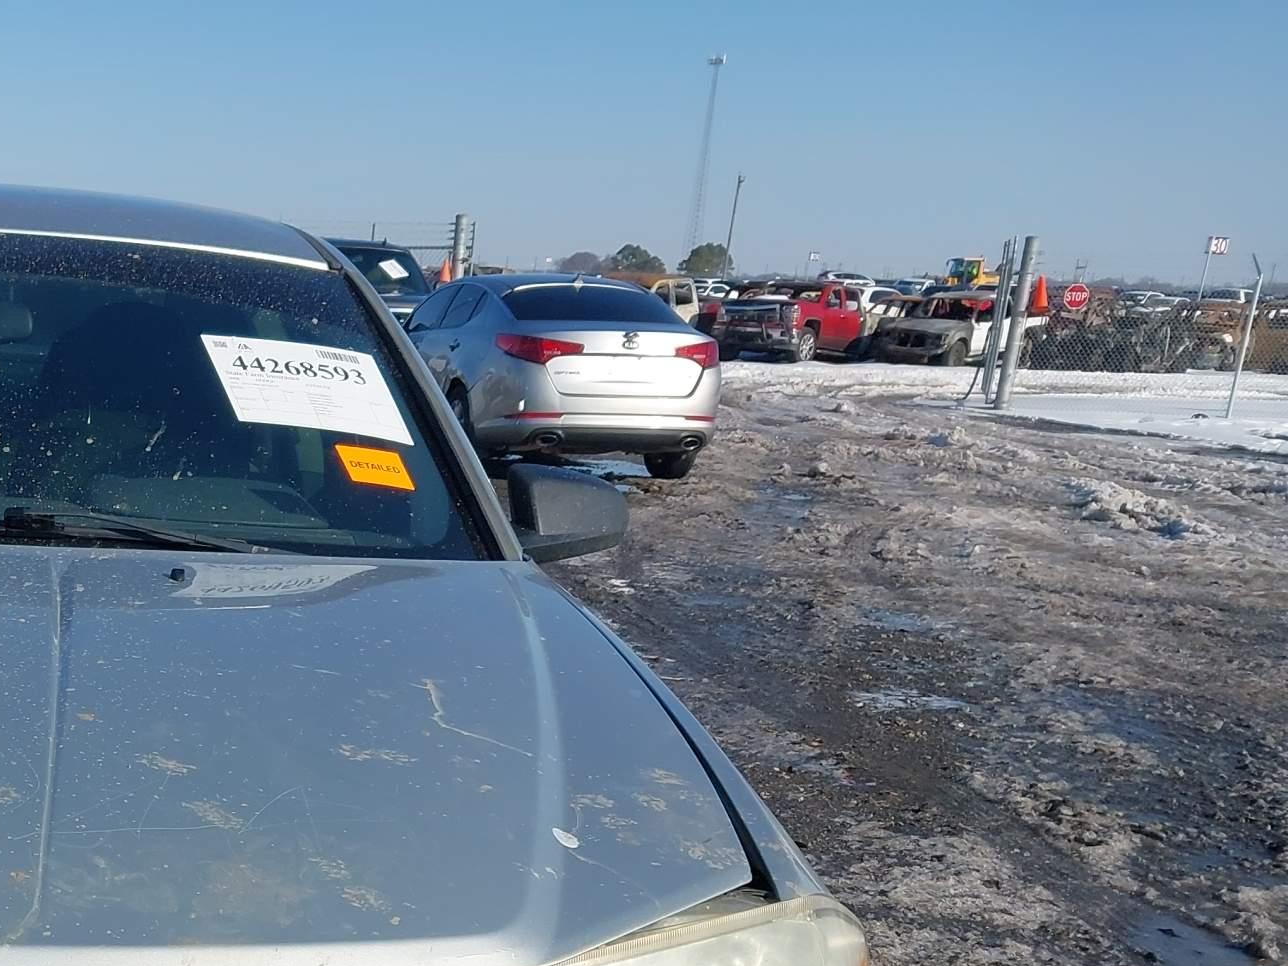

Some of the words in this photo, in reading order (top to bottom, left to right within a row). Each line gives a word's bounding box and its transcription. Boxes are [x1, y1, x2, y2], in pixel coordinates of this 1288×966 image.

[1065, 291, 1088, 302] STOP
[232, 355, 367, 385] 44268593
[349, 460, 401, 473] DETAILED
